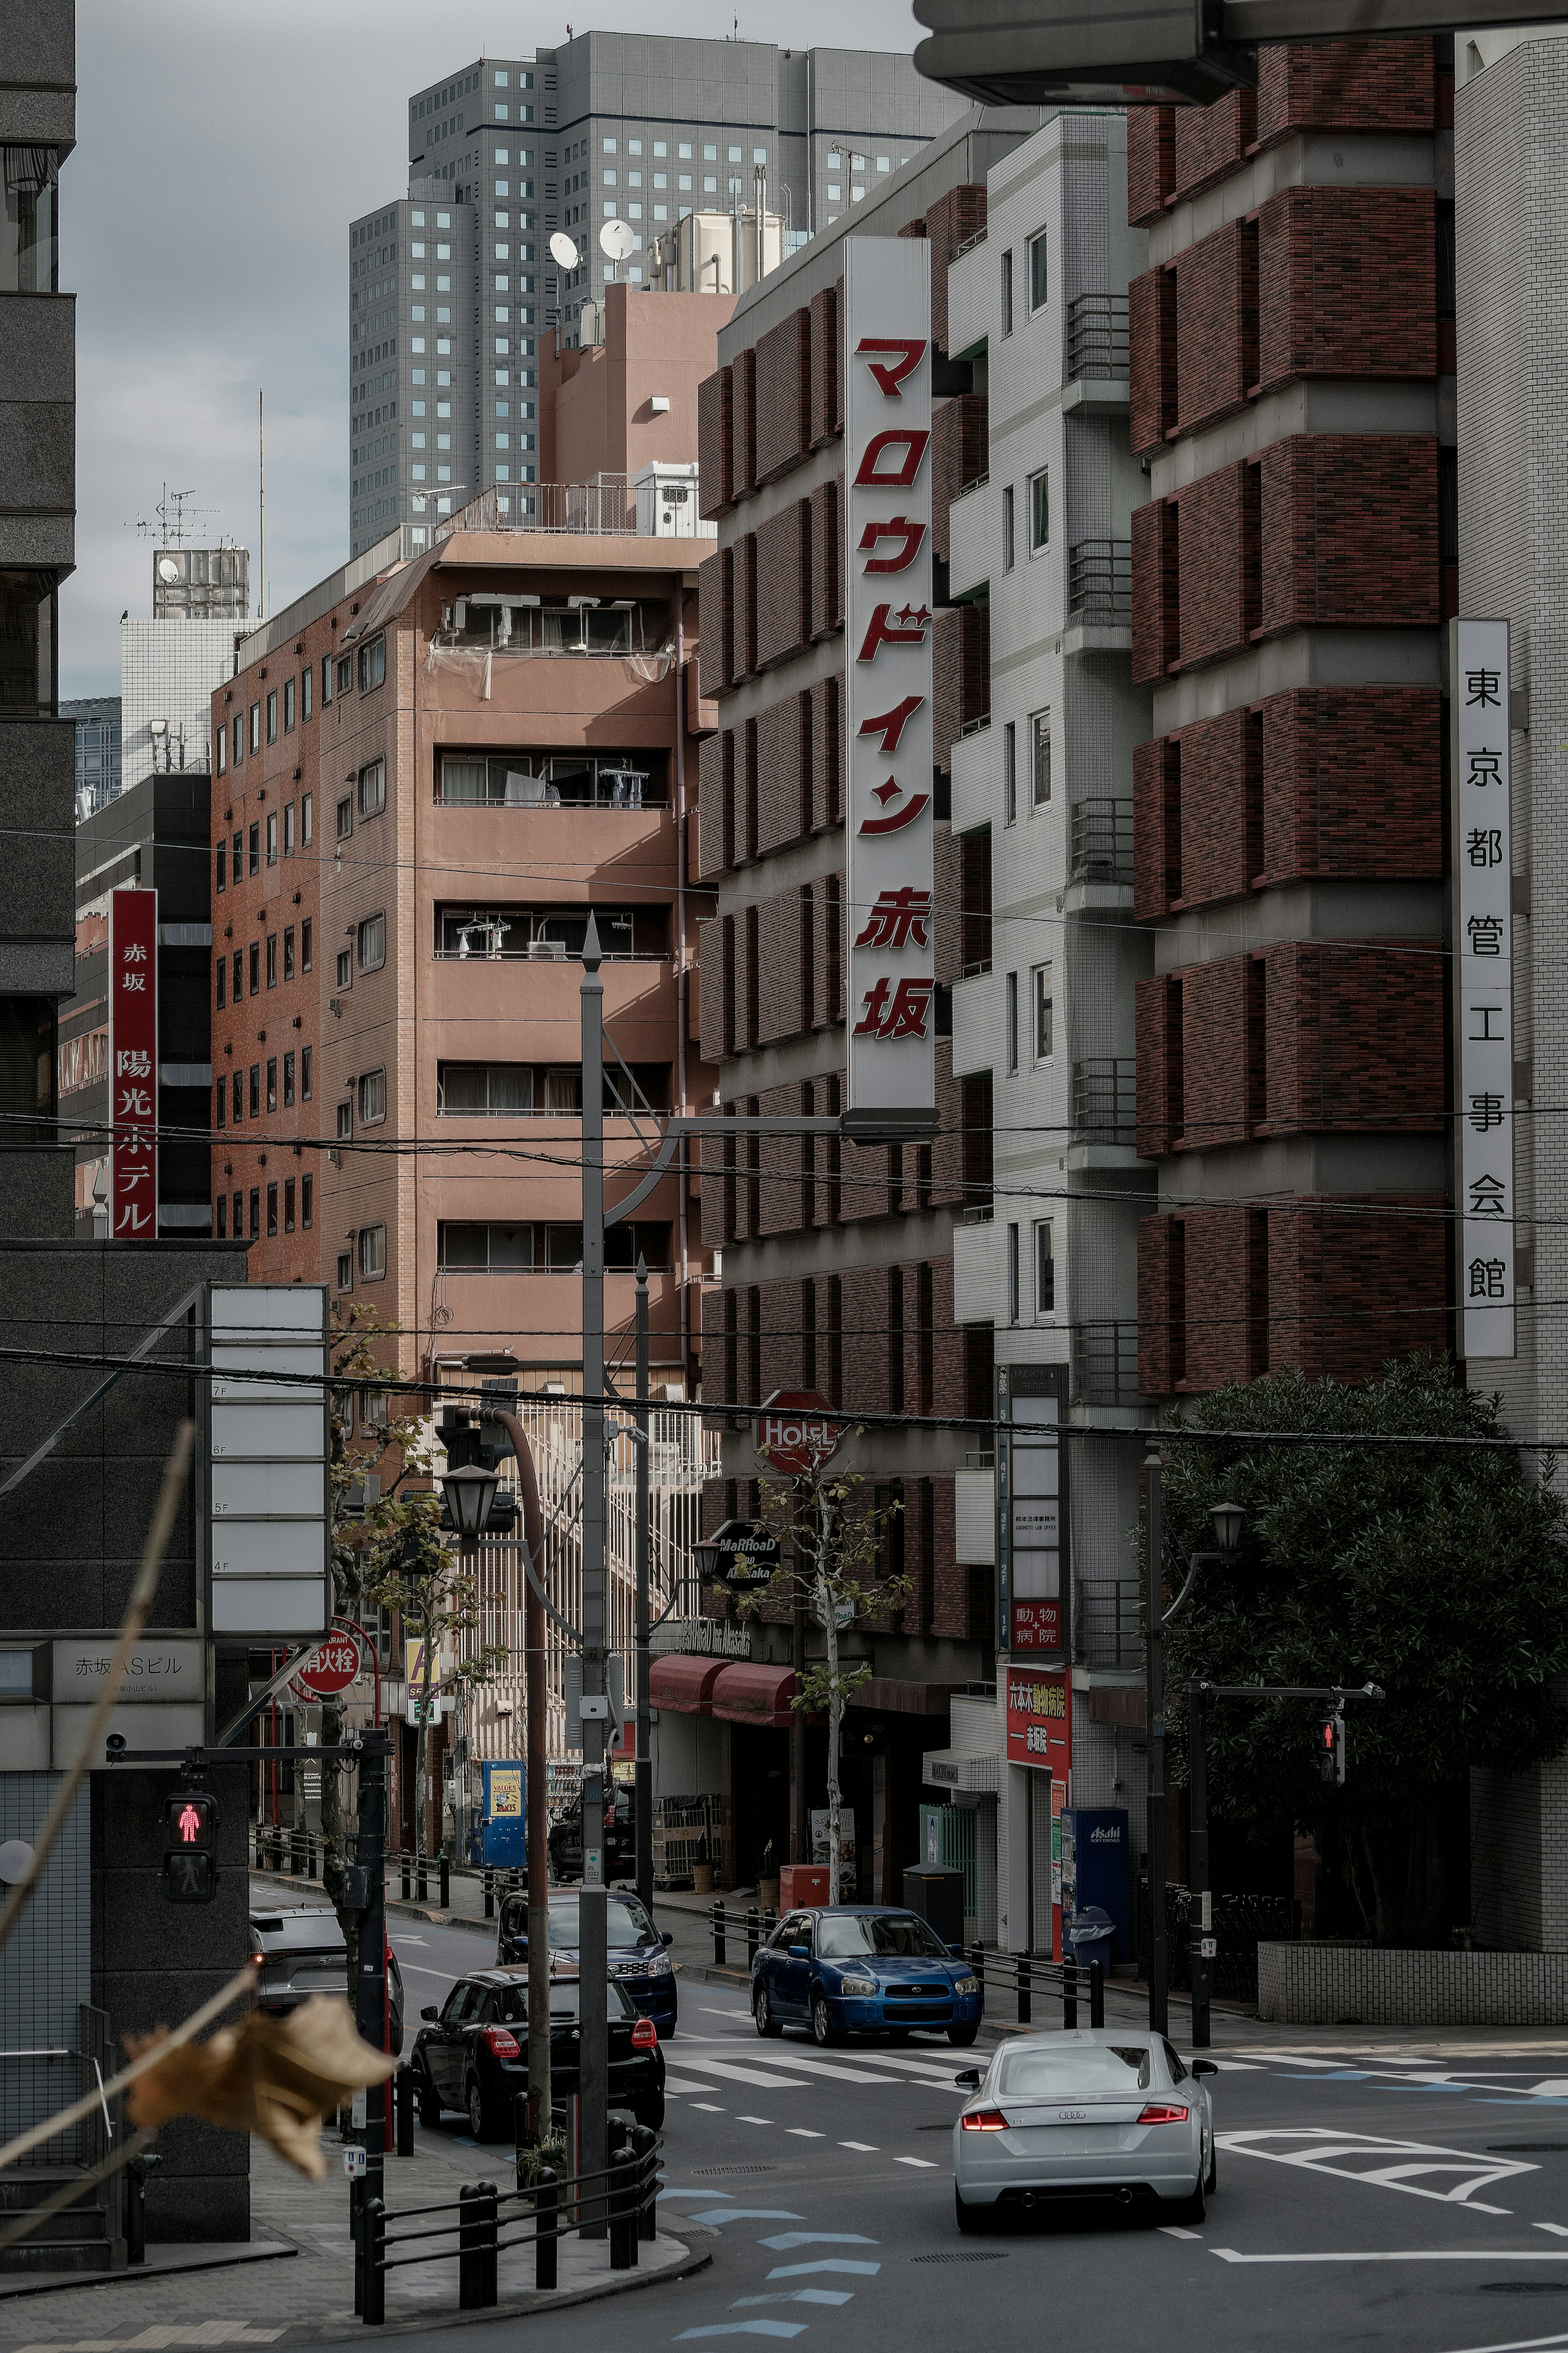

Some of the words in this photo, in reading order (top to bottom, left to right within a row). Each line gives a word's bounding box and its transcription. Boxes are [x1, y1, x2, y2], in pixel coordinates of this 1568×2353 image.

[122, 943, 147, 991] 赤坂
[1465, 668, 1506, 1298] 東京都管工事会館
[1009, 1680, 1065, 1718] 六本木動物病院
[1027, 1725, 1047, 1753] 赤坂院
[1091, 1826, 1120, 1839] Asahi
